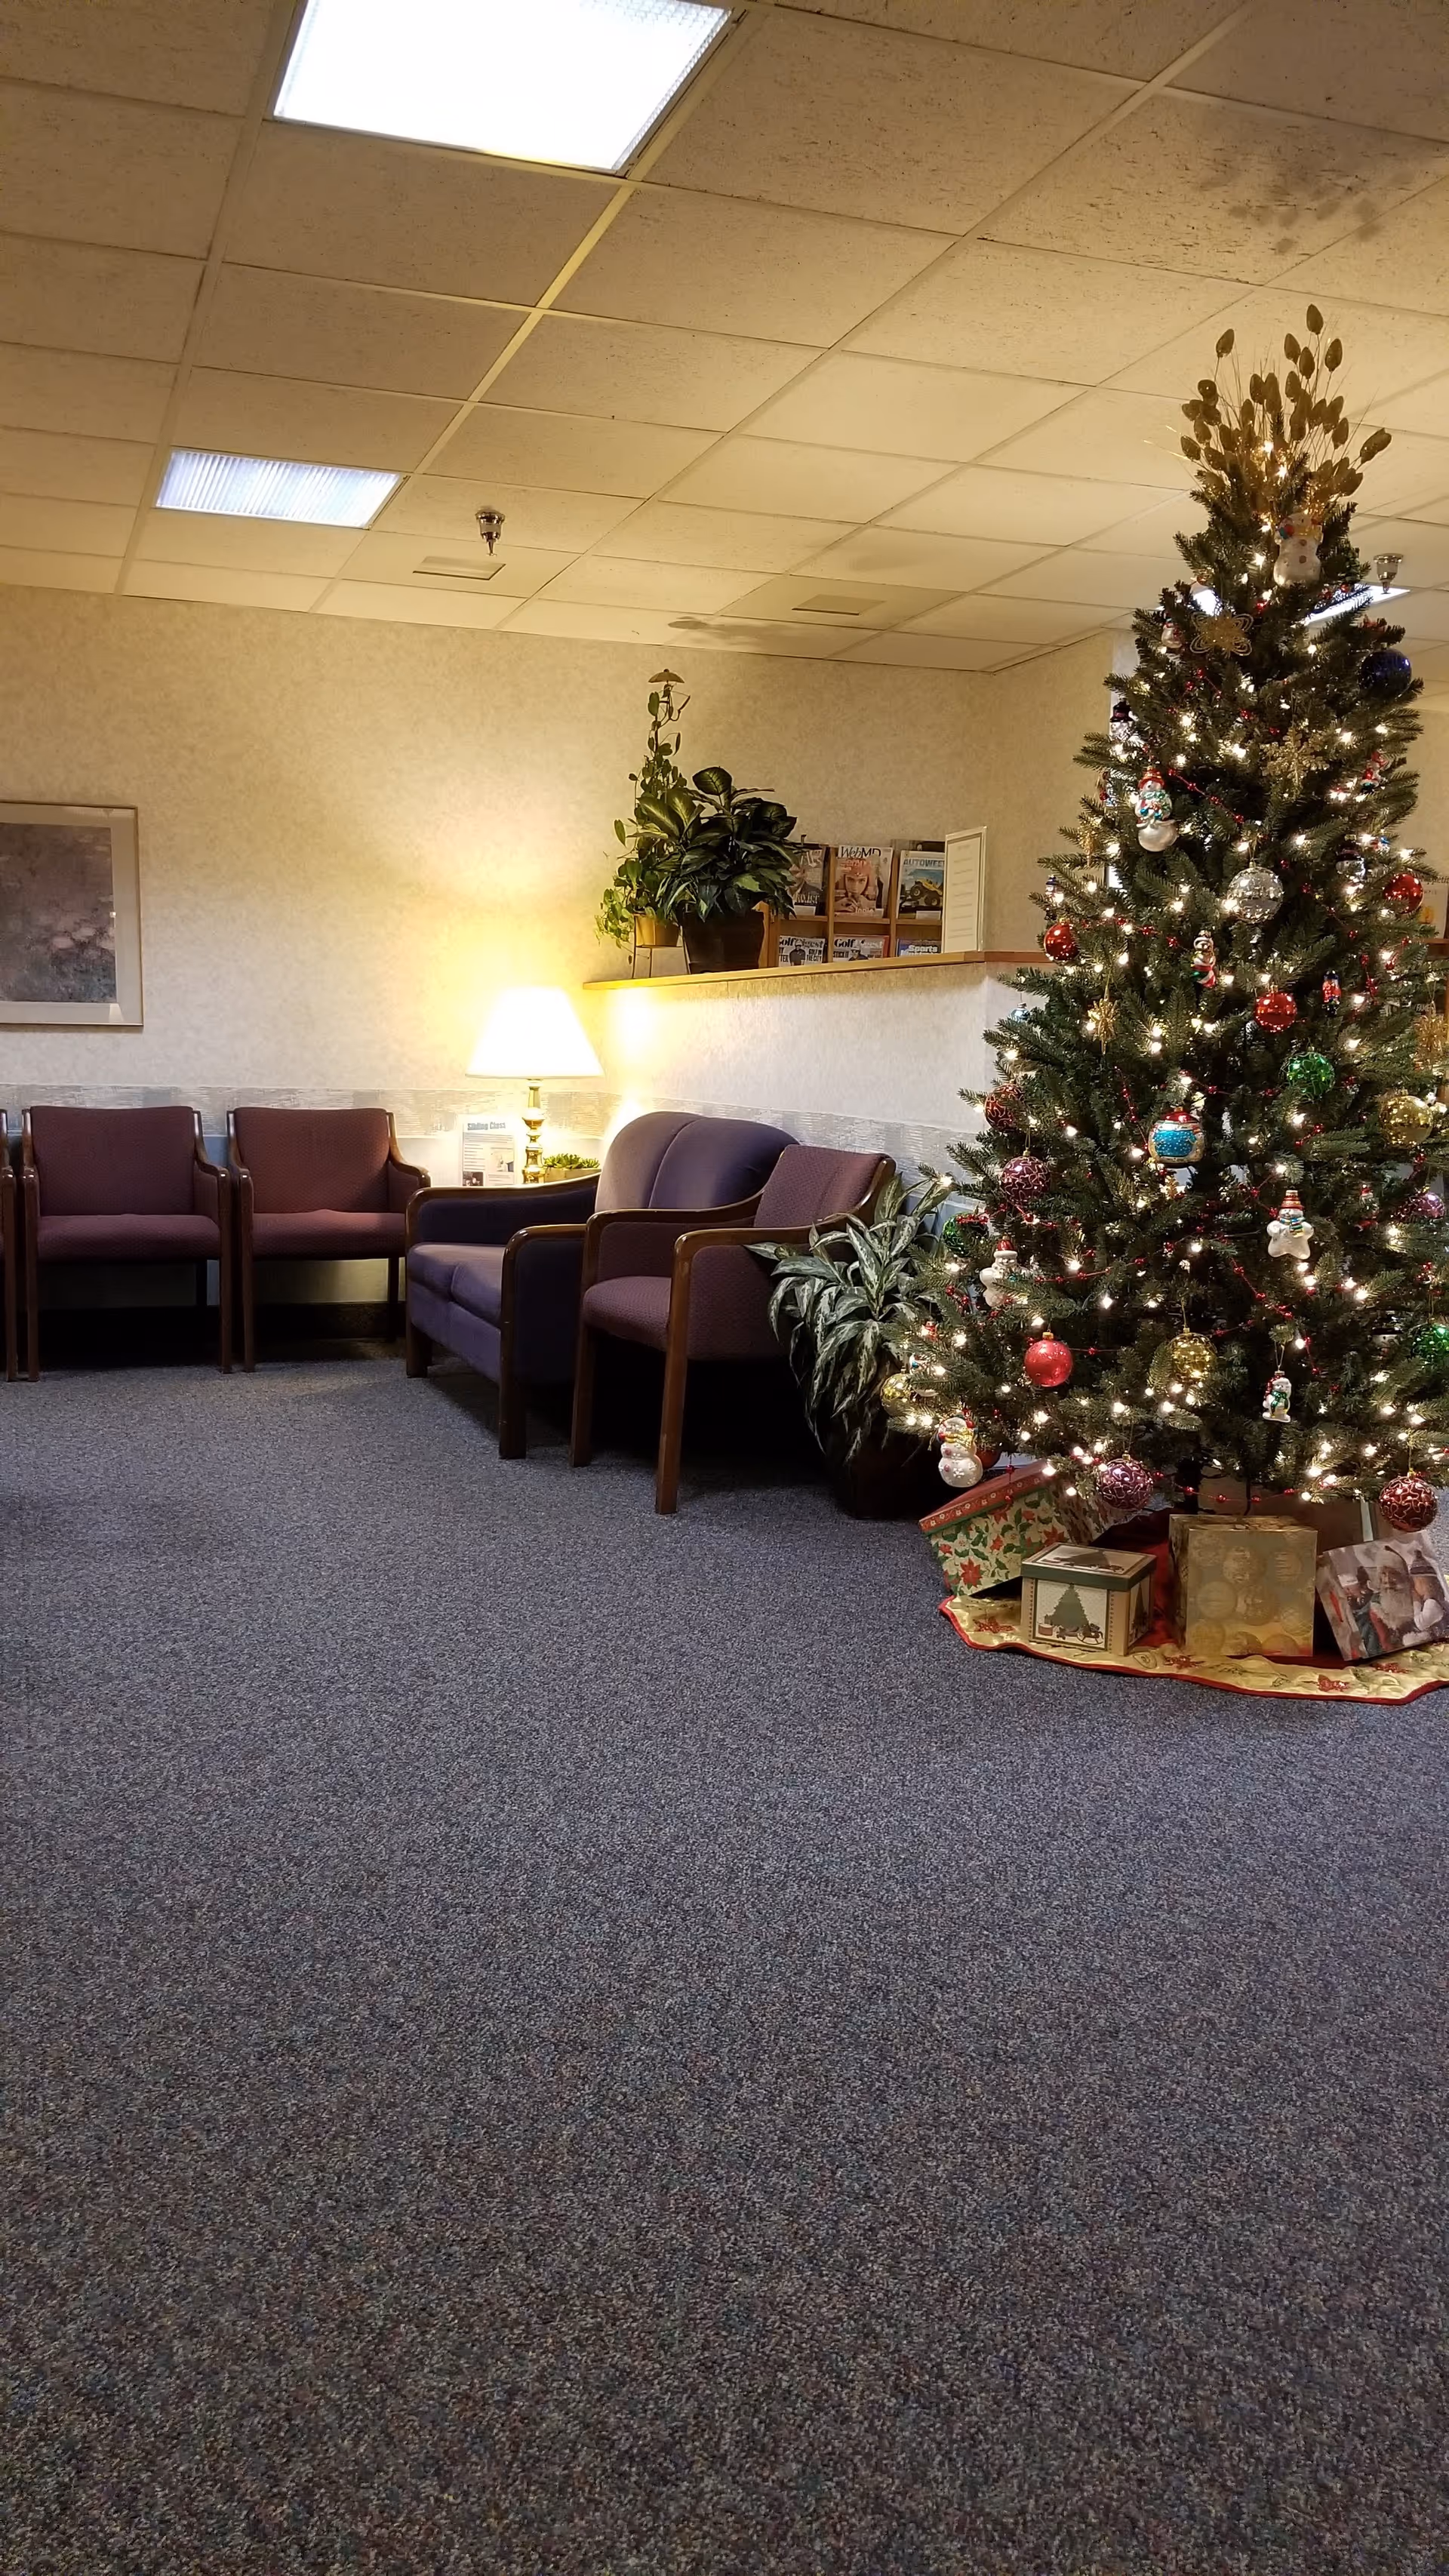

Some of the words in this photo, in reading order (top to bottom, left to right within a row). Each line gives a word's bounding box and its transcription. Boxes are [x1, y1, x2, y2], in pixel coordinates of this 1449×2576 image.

[841, 846, 881, 858] WebMD
[834, 938, 856, 948] Golf
[909, 944, 938, 953] Sports
